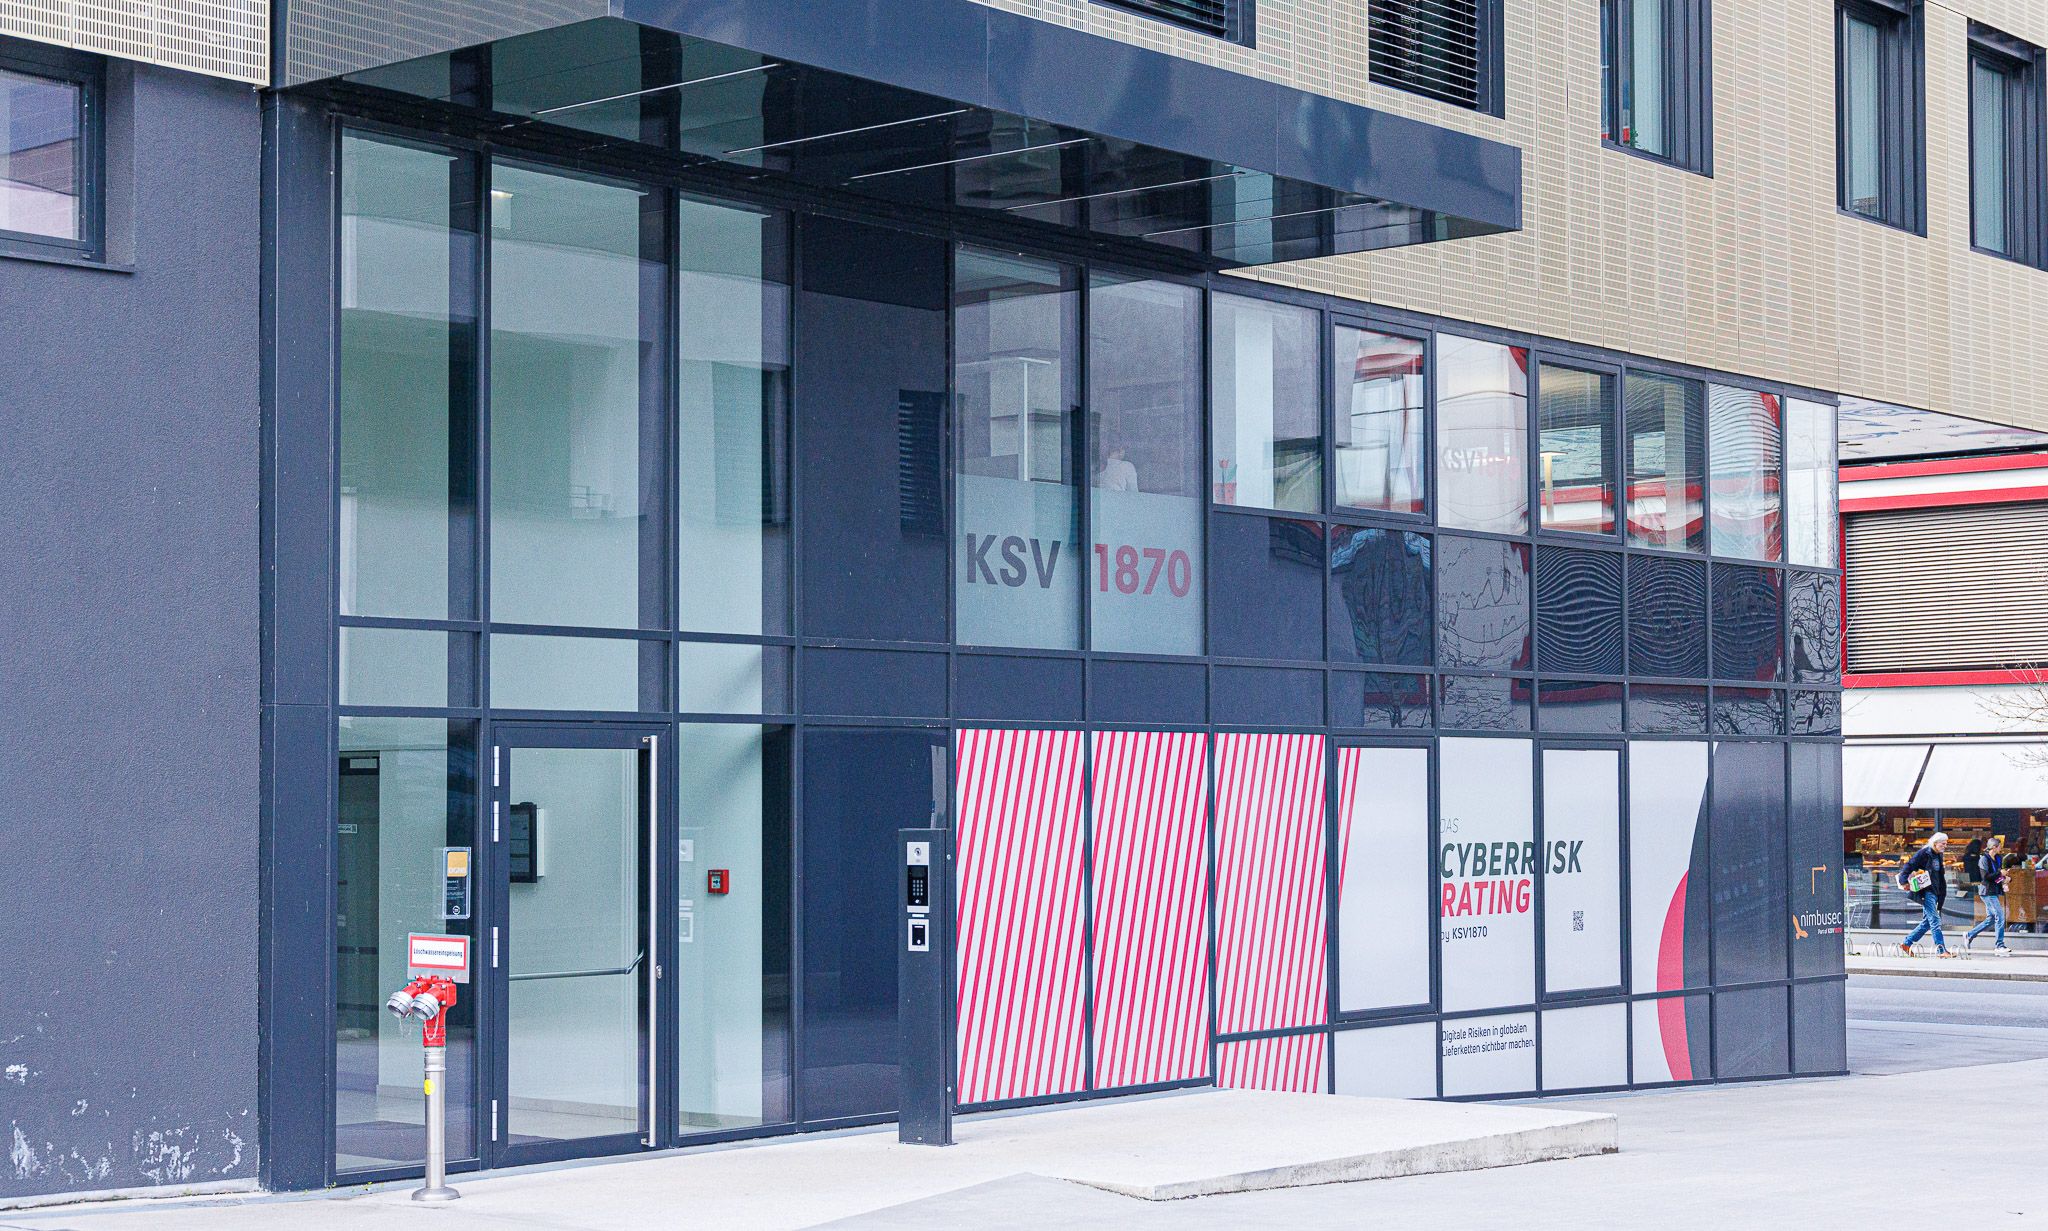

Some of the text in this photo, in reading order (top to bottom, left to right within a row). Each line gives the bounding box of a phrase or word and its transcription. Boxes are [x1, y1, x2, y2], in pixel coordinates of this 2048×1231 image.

[966, 532, 1192, 598] KSV 1870
[1440, 817, 1459, 833] DAS
[1441, 878, 1531, 918] RATING
[1800, 909, 1842, 927] nimbusec
[1452, 925, 1488, 940] KSV1870
[1442, 1023, 1528, 1043] Digitale Risiken in globalen
[1481, 1041, 1507, 1053] sichtbar
[1508, 1038, 1535, 1050] machen.
